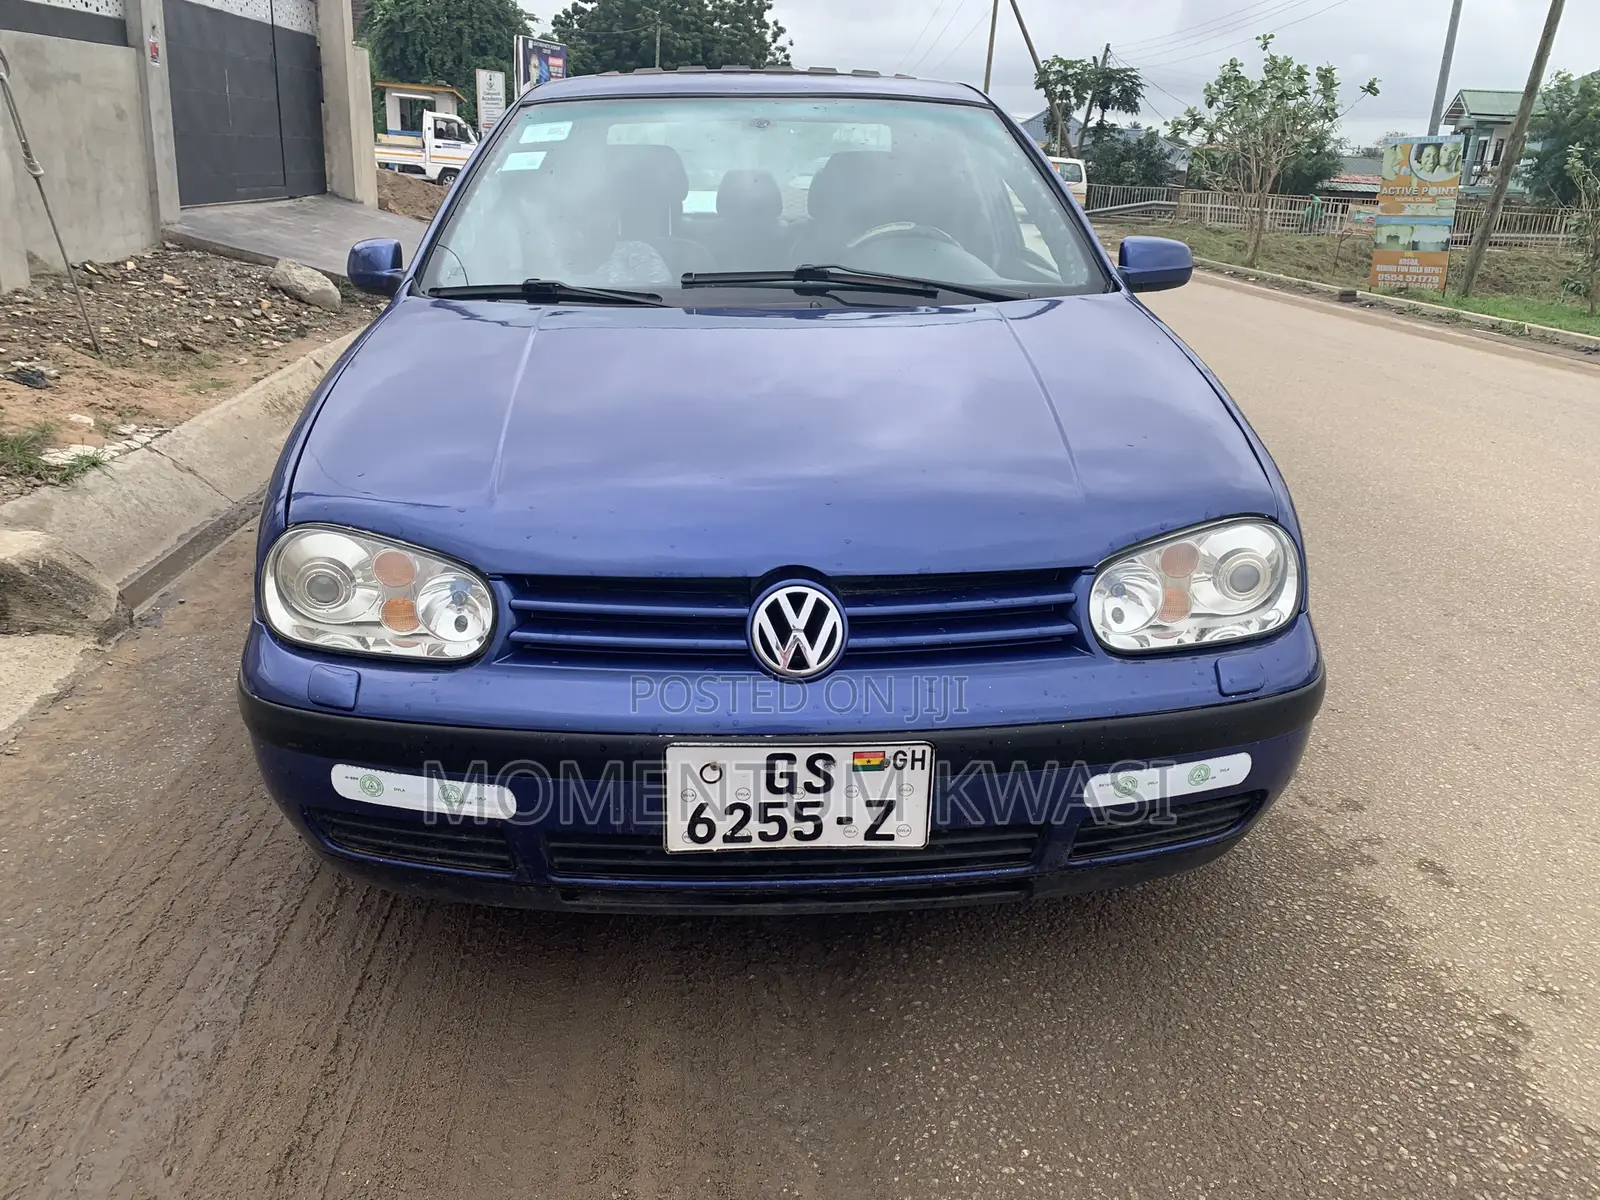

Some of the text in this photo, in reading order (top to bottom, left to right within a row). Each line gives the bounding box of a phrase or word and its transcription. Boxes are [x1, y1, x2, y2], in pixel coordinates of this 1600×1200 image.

[1381, 186, 1456, 196] ACTIVE POINT
[1424, 266, 1442, 274] DEPOT
[893, 750, 926, 771] GH
[765, 752, 836, 795] GS
[687, 799, 896, 845] 6255-Z
